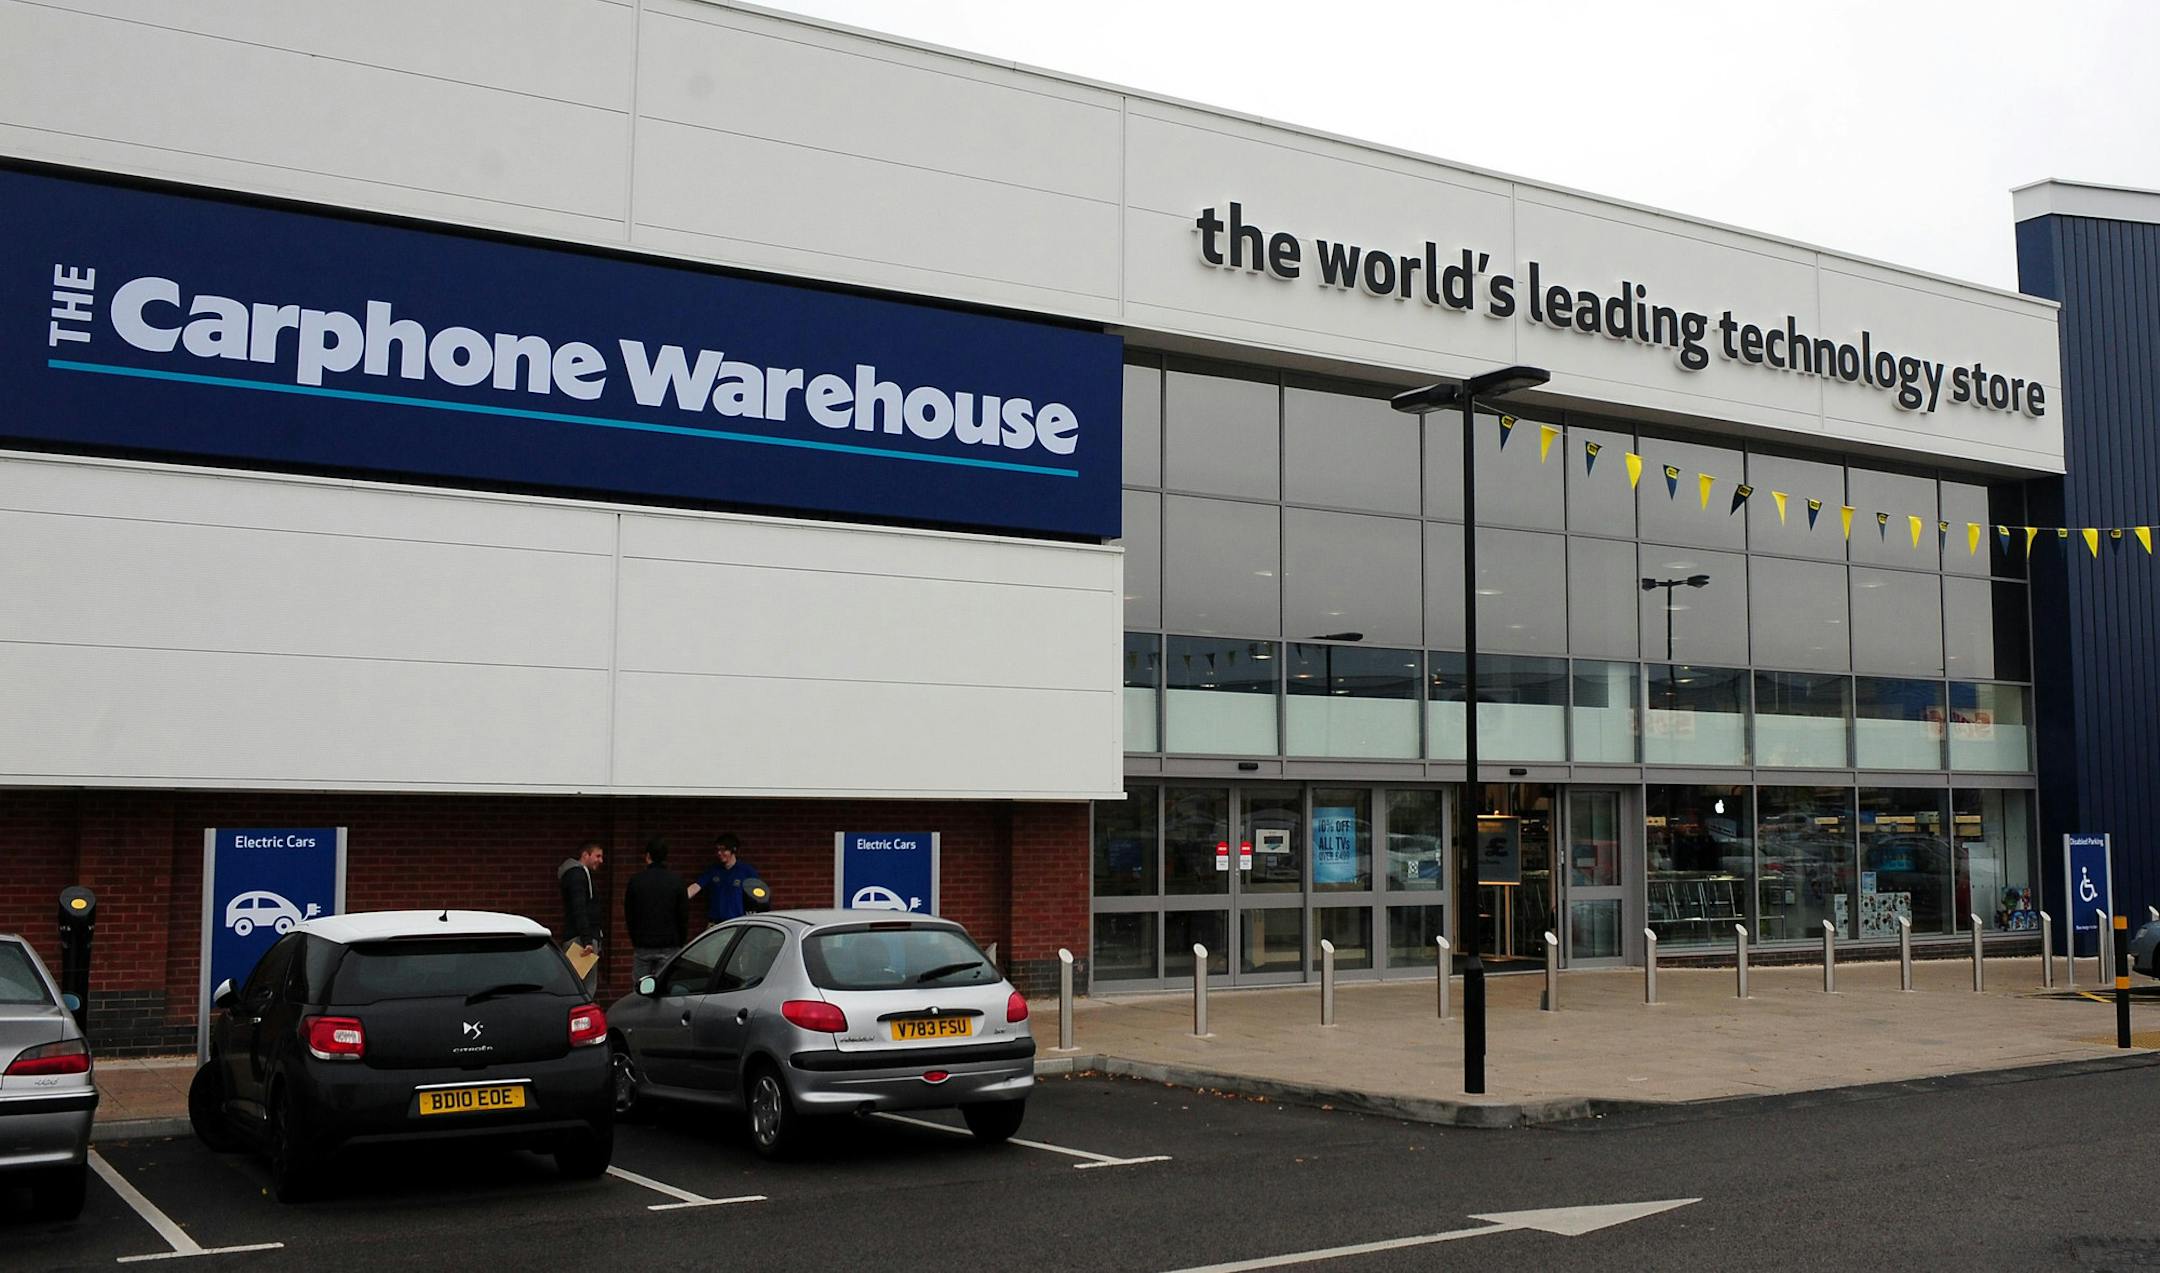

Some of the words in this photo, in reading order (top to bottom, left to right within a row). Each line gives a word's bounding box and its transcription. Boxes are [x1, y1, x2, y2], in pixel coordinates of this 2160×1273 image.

[49, 263, 96, 347] THE
[1197, 202, 1300, 278] the
[1316, 240, 1516, 319] world's
[1529, 262, 1709, 370] leading
[1719, 311, 1944, 413] technology
[1953, 363, 2045, 417] store
[110, 276, 607, 401] Carphone
[618, 338, 1080, 455] Warehouse
[1335, 820, 1351, 833] OFF
[234, 835, 284, 849] Electric
[286, 834, 317, 848] Cars
[856, 838, 893, 850] Electric
[893, 837, 917, 850] Cars
[1318, 836, 1334, 850] ALL
[1335, 836, 1351, 850] TVs
[897, 1020, 936, 1038] V783
[938, 1018, 967, 1036] FSU
[431, 1090, 472, 1111] BD10
